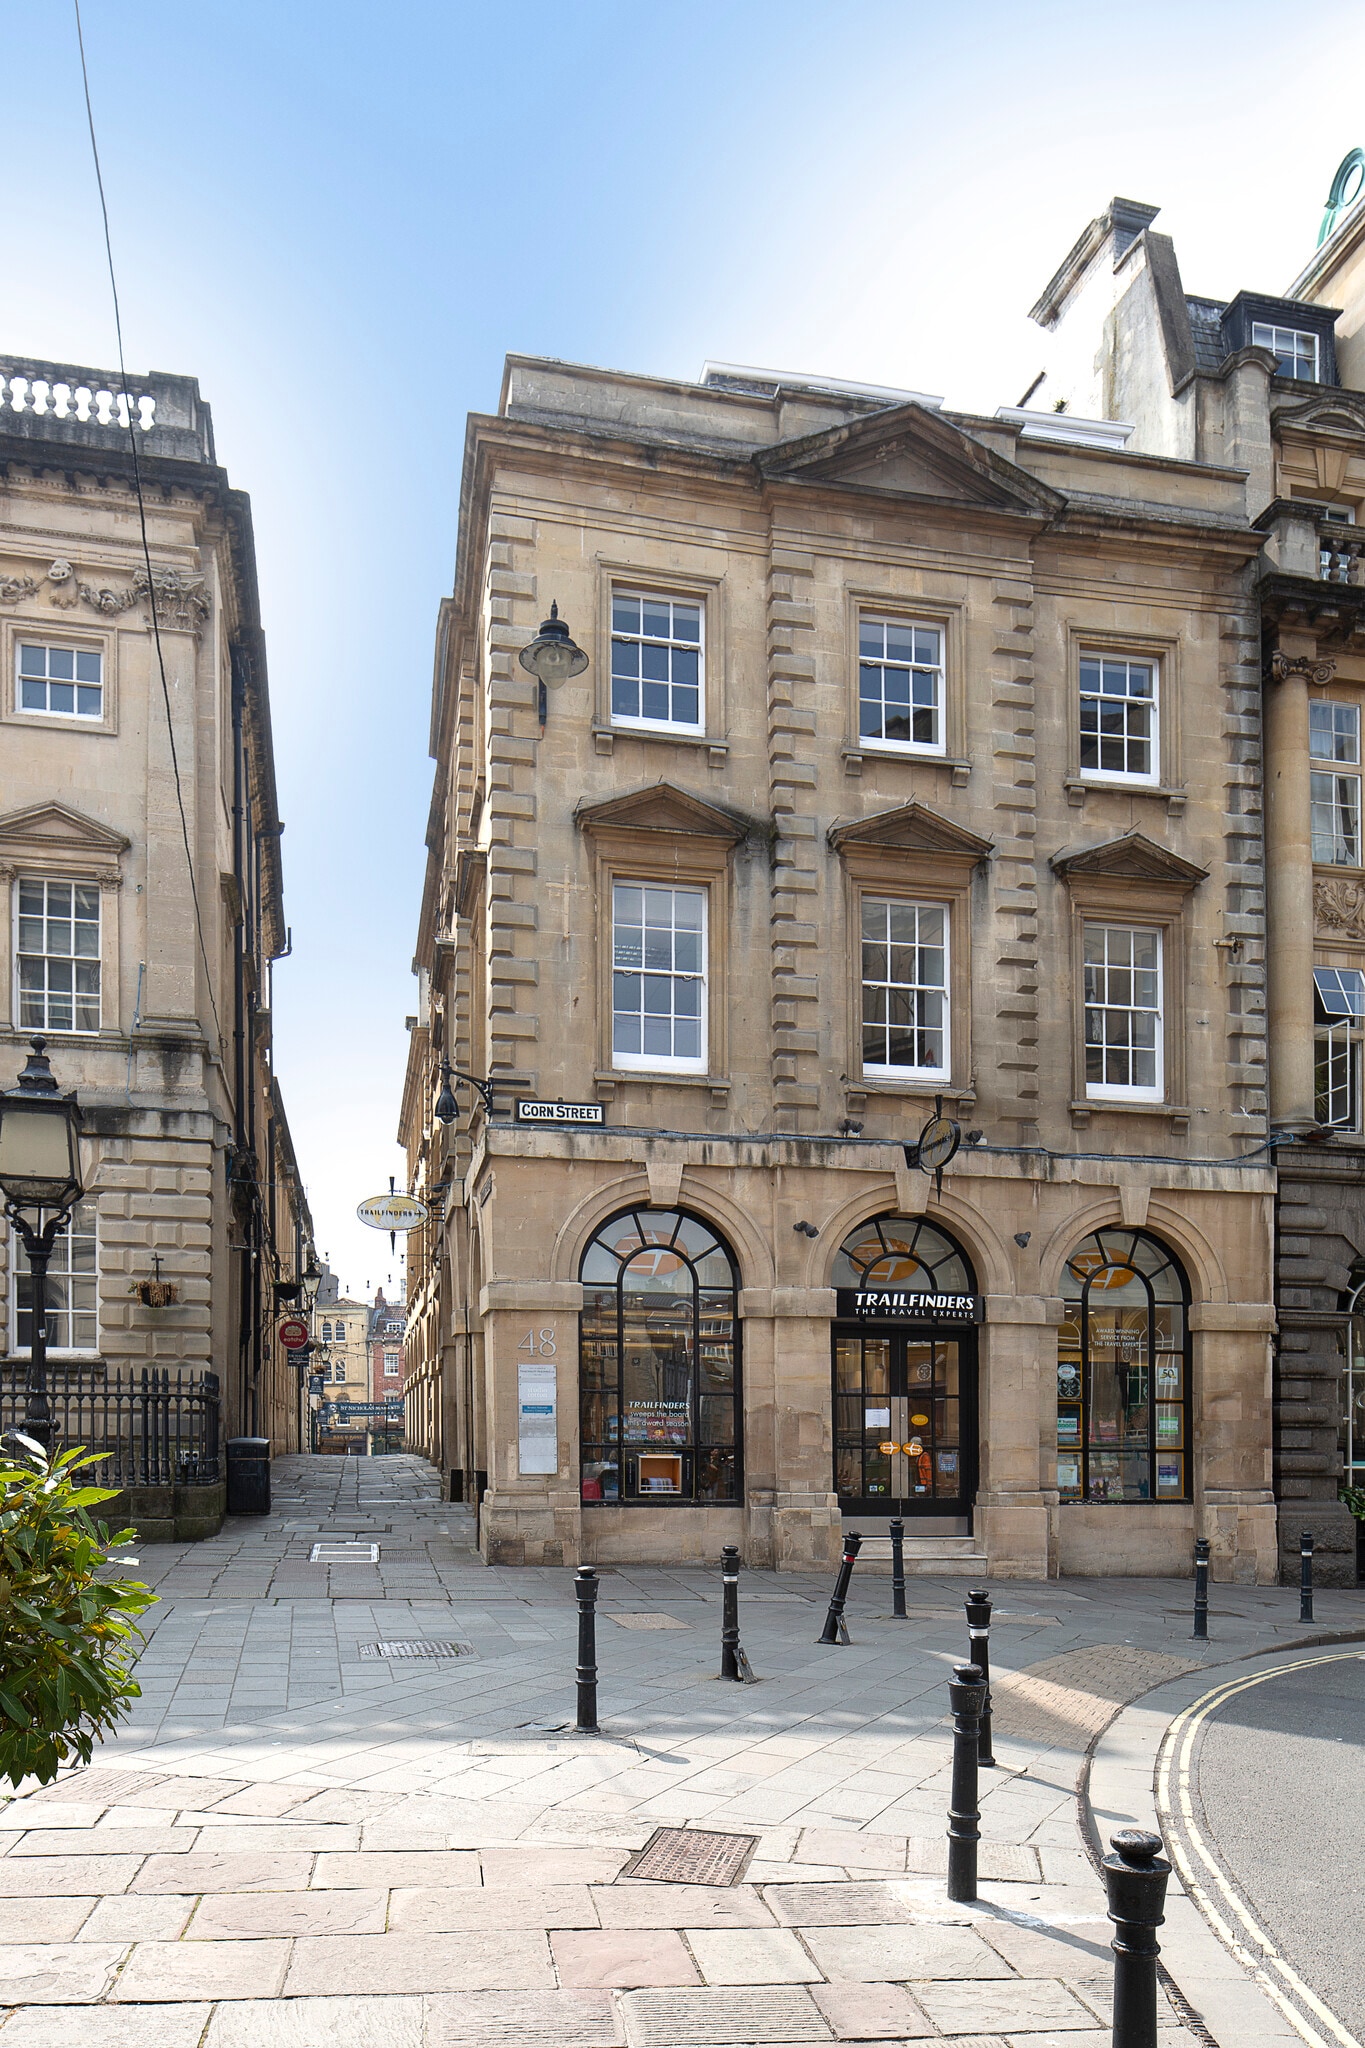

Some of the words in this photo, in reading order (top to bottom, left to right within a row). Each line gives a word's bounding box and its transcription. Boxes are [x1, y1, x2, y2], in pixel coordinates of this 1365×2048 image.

[522, 1103, 554, 1118] CORN
[556, 1105, 599, 1119] STREET
[361, 1209, 413, 1217] TRAILFINDERS
[855, 1293, 975, 1310] TRAILFINDERS
[885, 1308, 925, 1316] TRAVEL
[932, 1310, 974, 1319] EXPERTS
[517, 1327, 557, 1357] 48
[629, 1401, 691, 1410] TRAILFINDERS
[630, 1411, 655, 1419] sweeps
[656, 1410, 668, 1418] the
[669, 1410, 689, 1419] board
[641, 1419, 664, 1427] award
[666, 1420, 690, 1428] season
